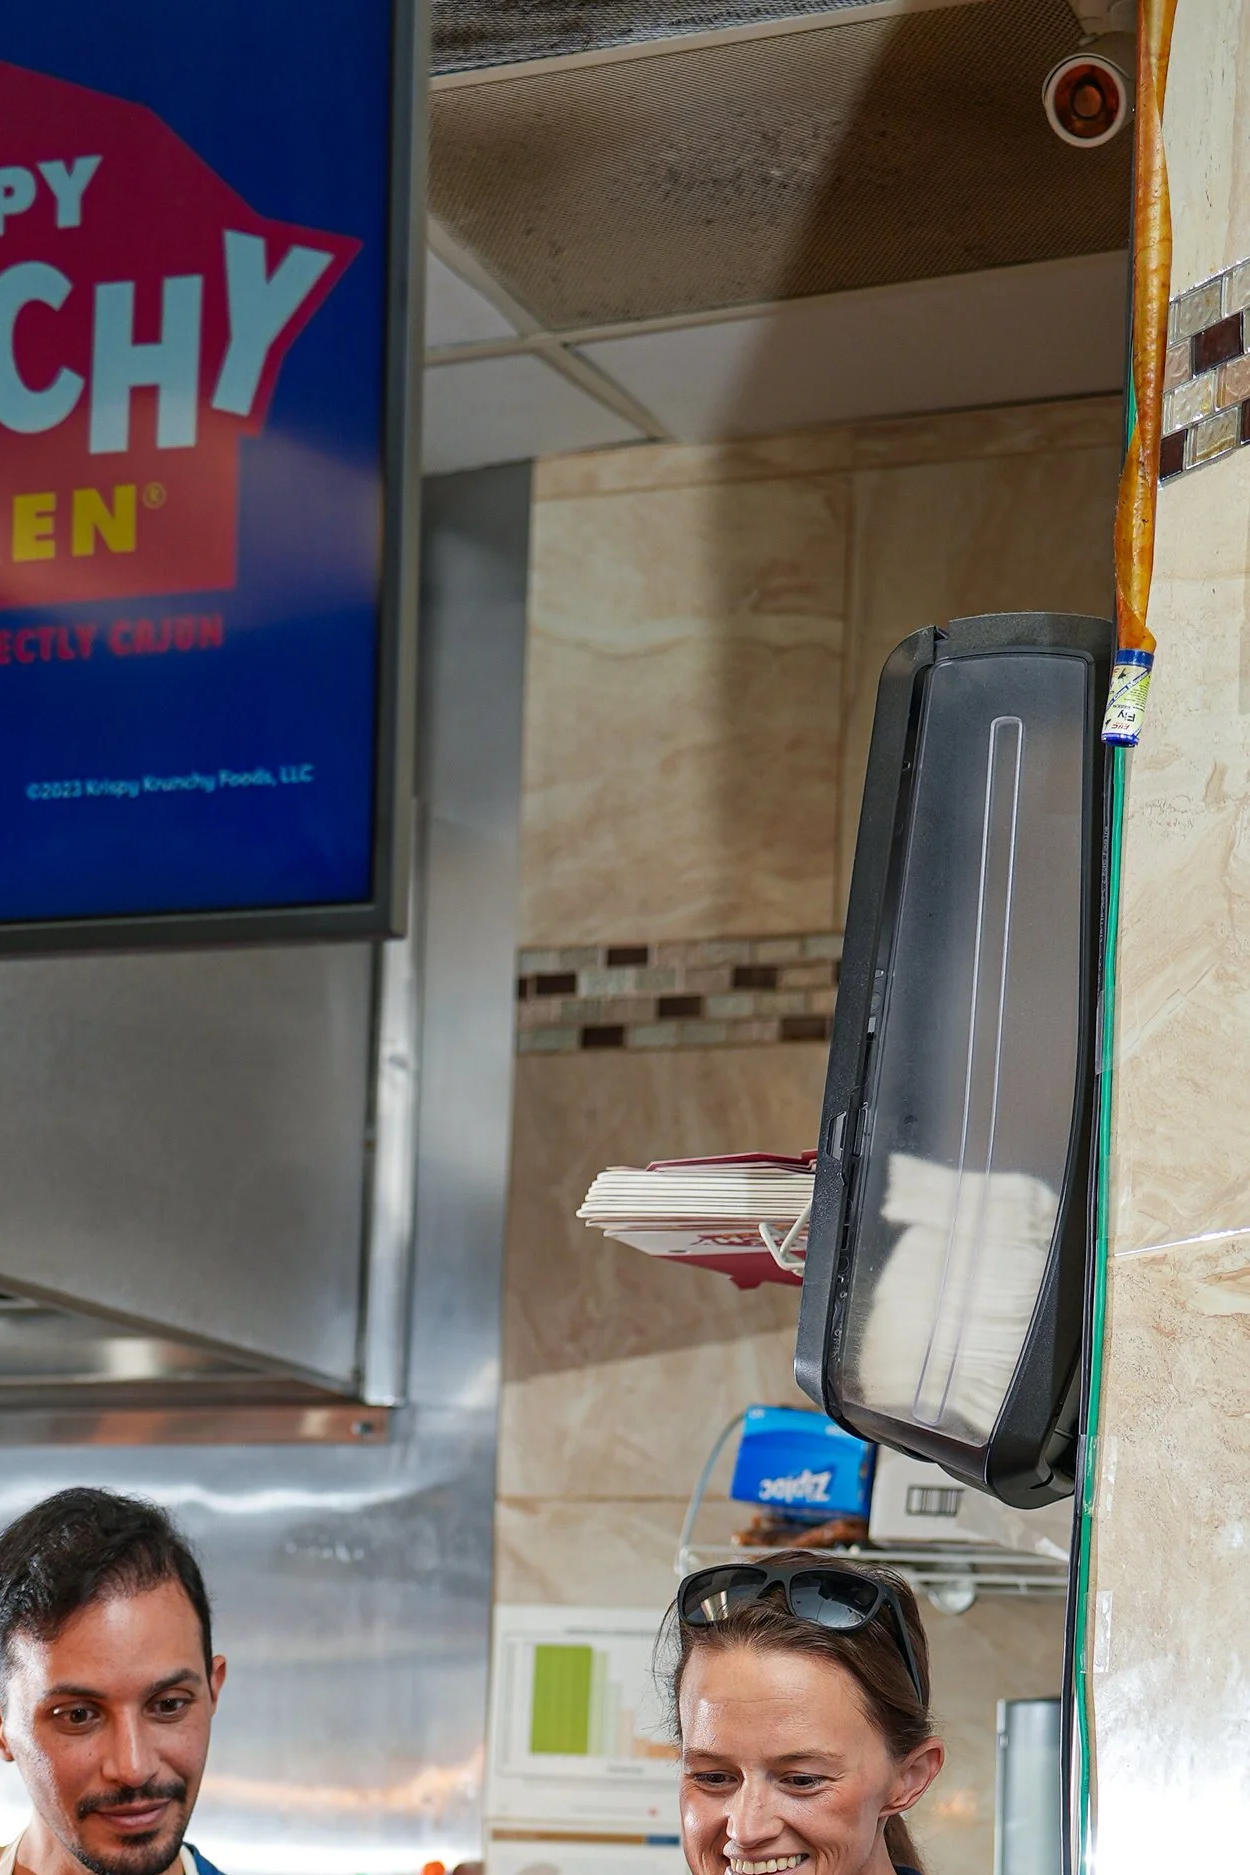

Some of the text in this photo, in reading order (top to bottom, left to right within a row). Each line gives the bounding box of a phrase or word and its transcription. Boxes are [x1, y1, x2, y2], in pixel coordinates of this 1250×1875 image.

[108, 615, 223, 655] CAJUN
[85, 778, 140, 798] Krispy
[143, 771, 215, 793] Krunchy
[758, 1469, 831, 1503] Ziploc
